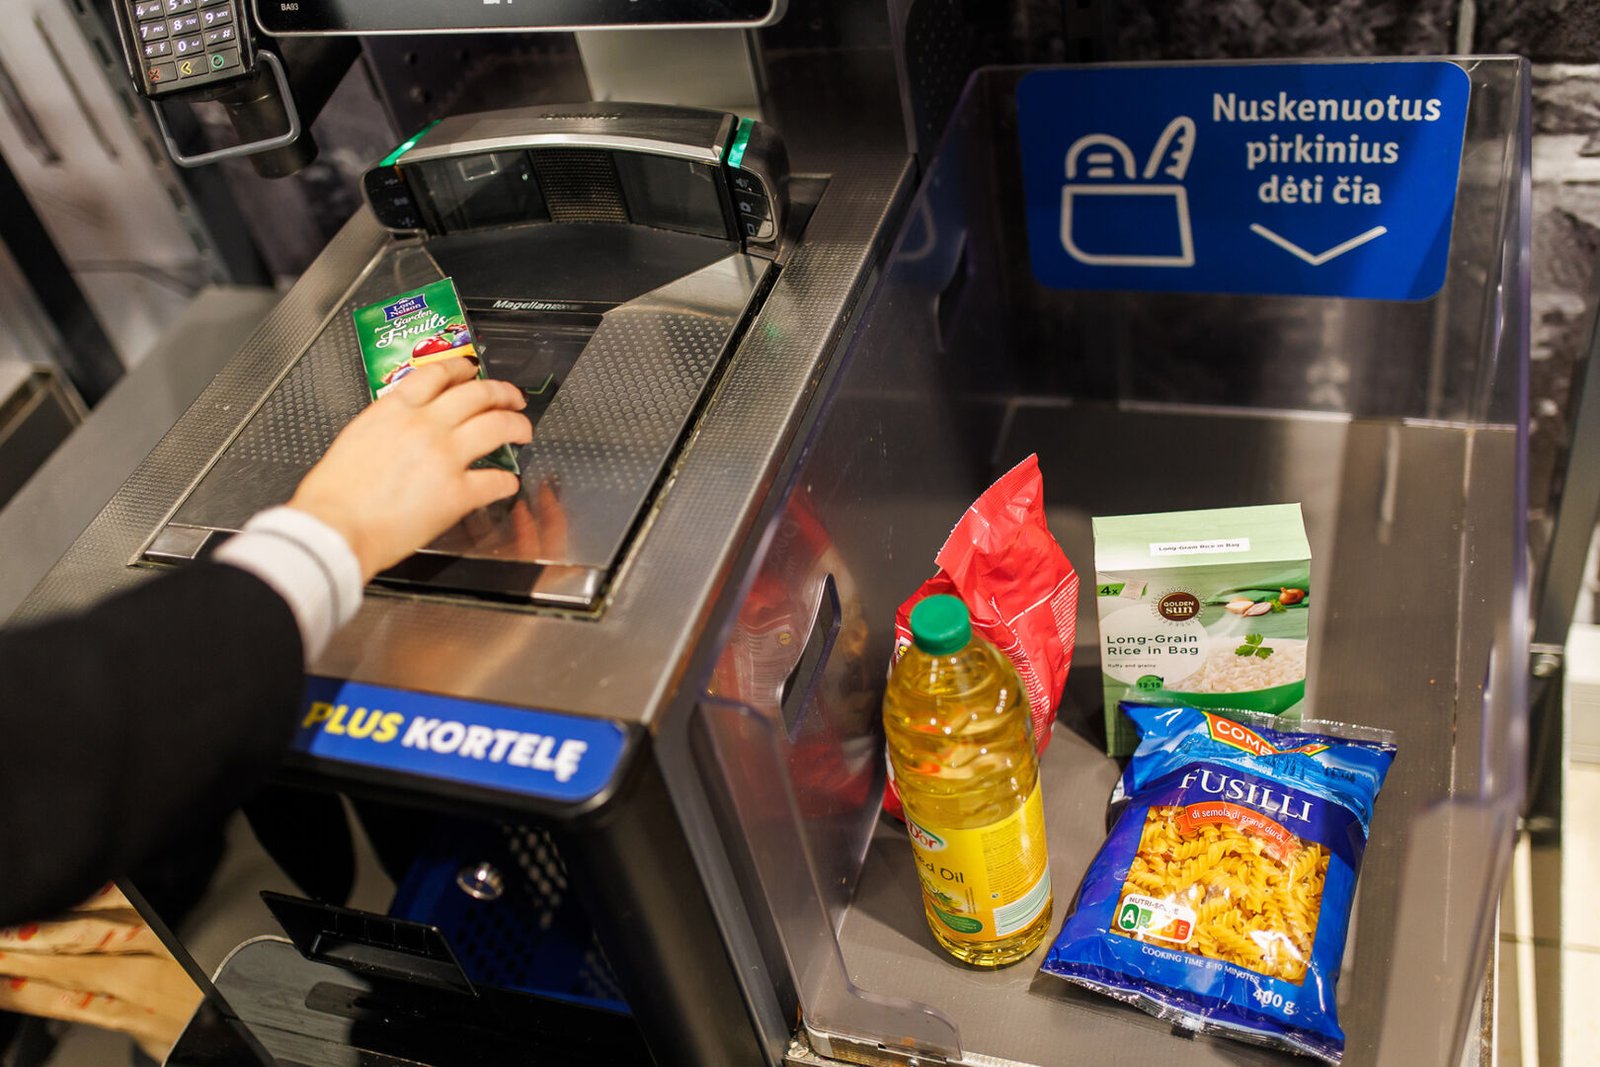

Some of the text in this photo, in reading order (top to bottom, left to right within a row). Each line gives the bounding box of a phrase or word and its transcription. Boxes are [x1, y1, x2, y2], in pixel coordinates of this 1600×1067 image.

[136, 6, 145, 16] 4
[205, 12, 214, 24] 9
[140, 26, 148, 38] 7
[173, 20, 183, 31] 8
[178, 41, 187, 52] 0
[1212, 91, 1442, 122] Nuskenuotus
[1246, 133, 1399, 171] pirkinius
[1258, 174, 1382, 205] dėti čia
[390, 303, 422, 318] Nelson
[393, 299, 415, 312] Lord
[492, 300, 553, 311] Magellan
[393, 309, 433, 328] Garden
[375, 313, 449, 349] Fruits
[1100, 586, 1119, 596] 4x
[1163, 600, 1195, 608] GOLDEN
[1106, 634, 1198, 647] Long-Grain
[1107, 645, 1200, 657] Rice in Bag
[302, 701, 588, 783] PLUS KORTELĘ
[1216, 720, 1274, 756] COMB
[1178, 767, 1314, 824] FUSILLI
[1192, 809, 1200, 819] di
[1202, 808, 1230, 818] semola
[1232, 811, 1240, 819] di
[940, 867, 964, 884] Oil
[1129, 896, 1180, 915] NUTRI-SCE
[1121, 909, 1136, 925] A
[1178, 924, 1187, 936] E
[1141, 946, 1182, 963] COOKING
[1183, 957, 1205, 969] TIME
[1224, 965, 1260, 984] MINUTES
[1252, 989, 1296, 1016] 400 g
